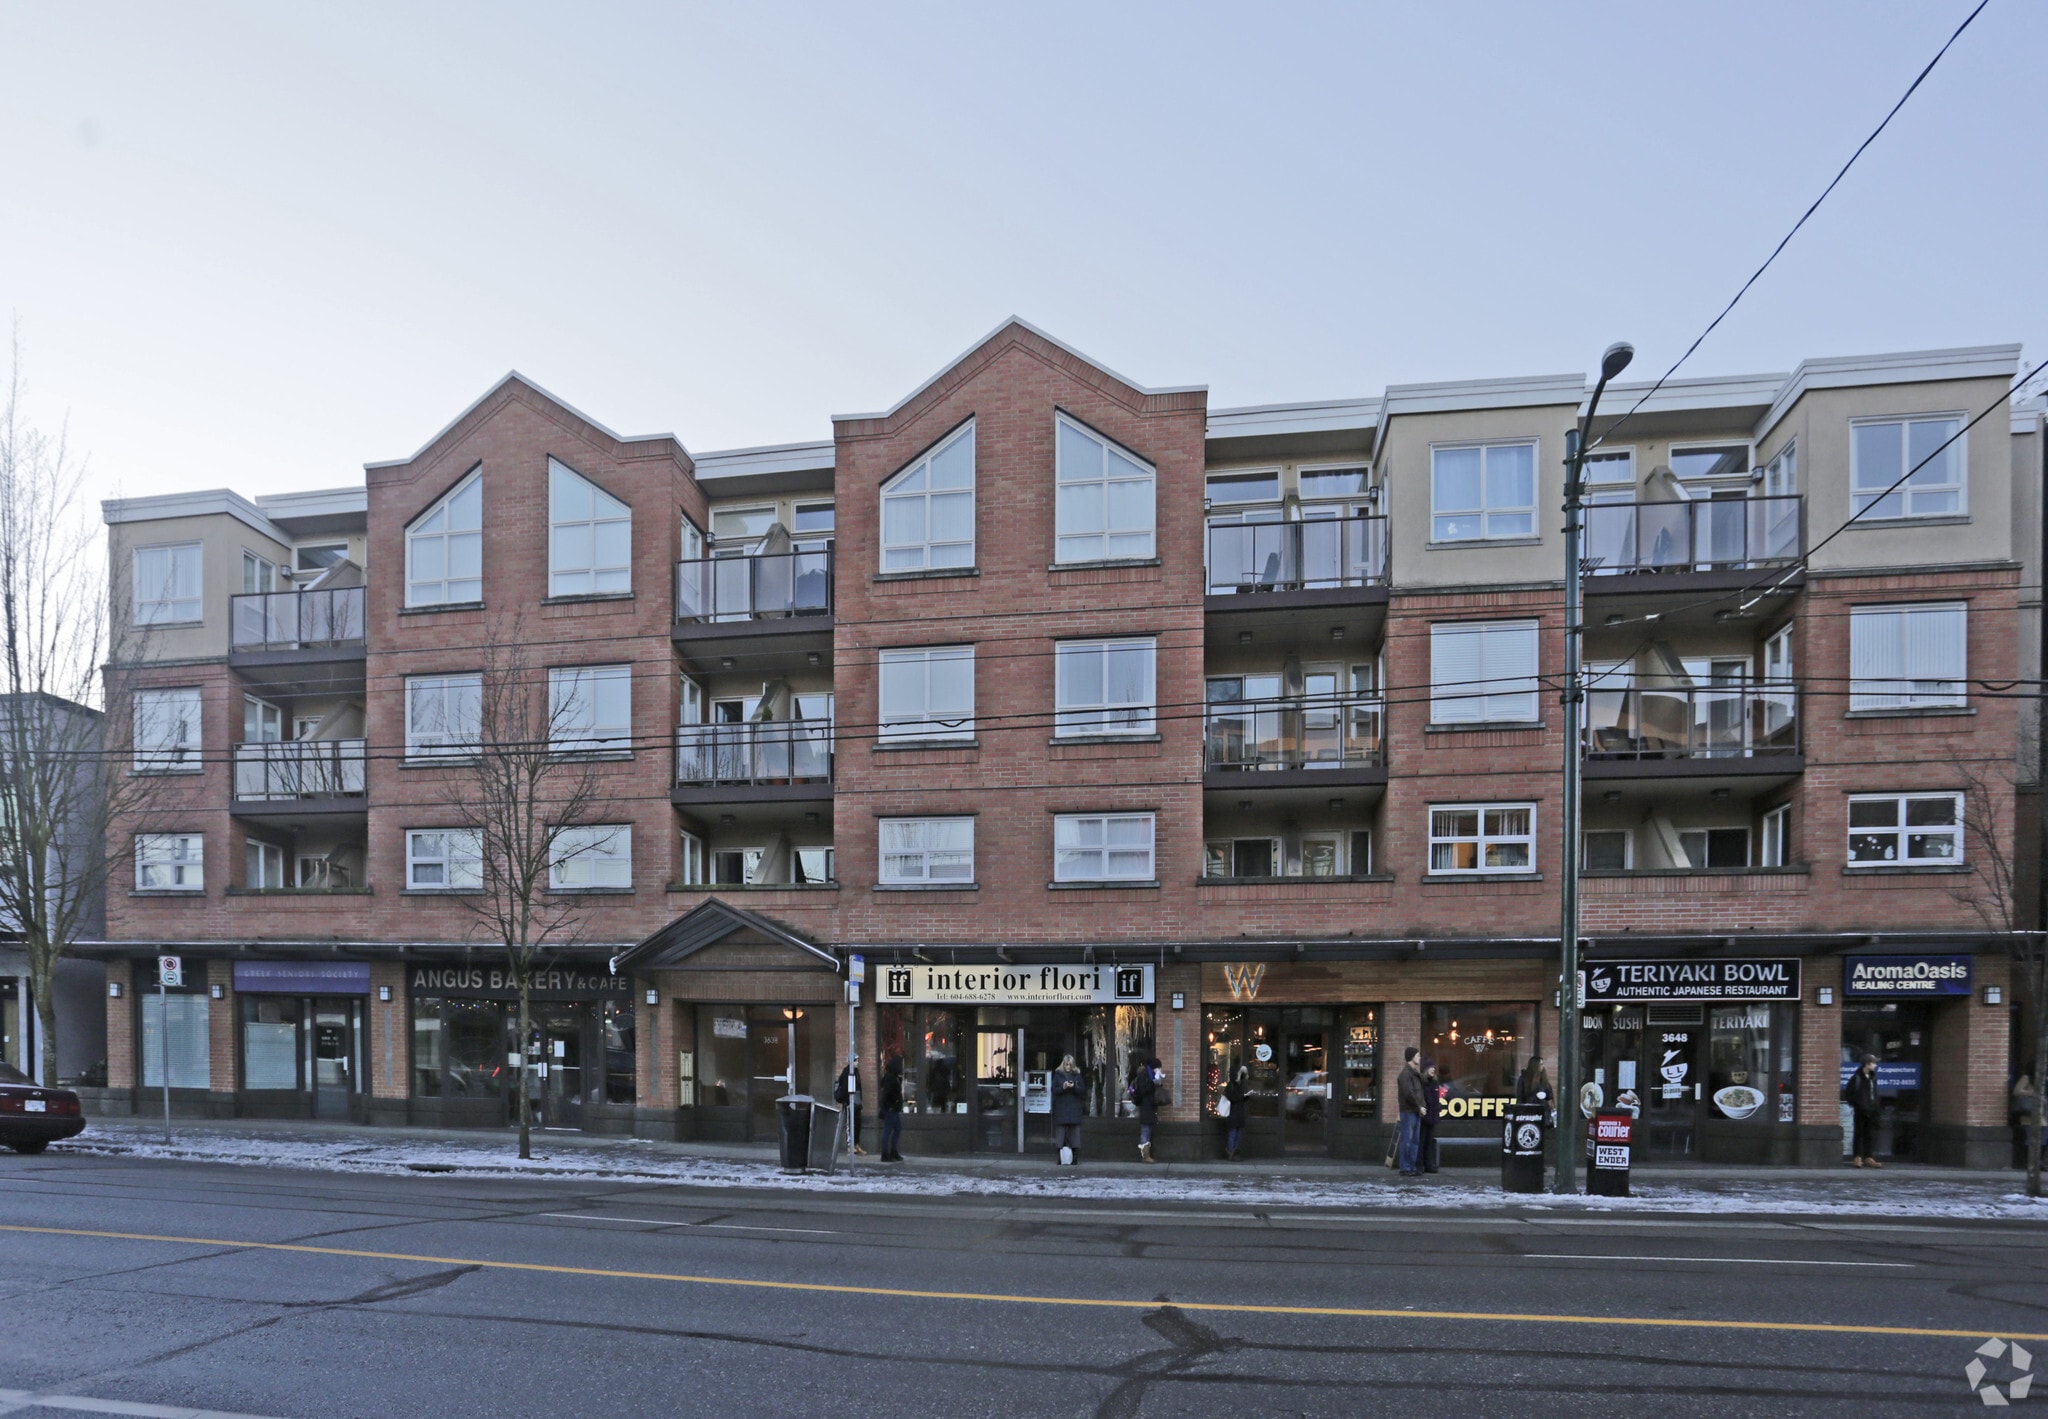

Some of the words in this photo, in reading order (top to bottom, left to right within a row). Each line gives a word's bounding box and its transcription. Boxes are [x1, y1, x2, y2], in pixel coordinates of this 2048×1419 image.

[321, 970, 359, 978] SOCIETY
[1616, 964, 1716, 983] TERIYAKI
[1724, 964, 1790, 982] BOWL
[1852, 962, 1968, 979] AromaOasis
[414, 969, 484, 989] ANGUS
[577, 976, 586, 990] &
[588, 976, 627, 991] CAFE
[891, 974, 908, 993] if
[927, 967, 1031, 991] interior
[1040, 966, 1101, 991] flori
[1121, 974, 1138, 993] if
[1223, 963, 1266, 1000] W
[1616, 986, 1671, 997] AUTHENTIC
[1672, 986, 1722, 996] JAPANESE
[1725, 985, 1788, 995] RESTAURANT
[1852, 981, 1895, 990] HEALING
[1896, 981, 1936, 990] CENTRE
[1007, 993, 1092, 1001] www.interiorflori.com
[1583, 1016, 1603, 1029] UDON
[1612, 1017, 1643, 1030] SUSHI
[1713, 1015, 1768, 1029] TERIYAKI
[1661, 1033, 1688, 1043] 3648
[1877, 1066, 1917, 1074] Acupuncture
[1439, 1097, 1518, 1117] COFFE
[1598, 1125, 1631, 1138] courier
[1599, 1147, 1624, 1156] WEST
[1598, 1156, 1627, 1165] ENDER
